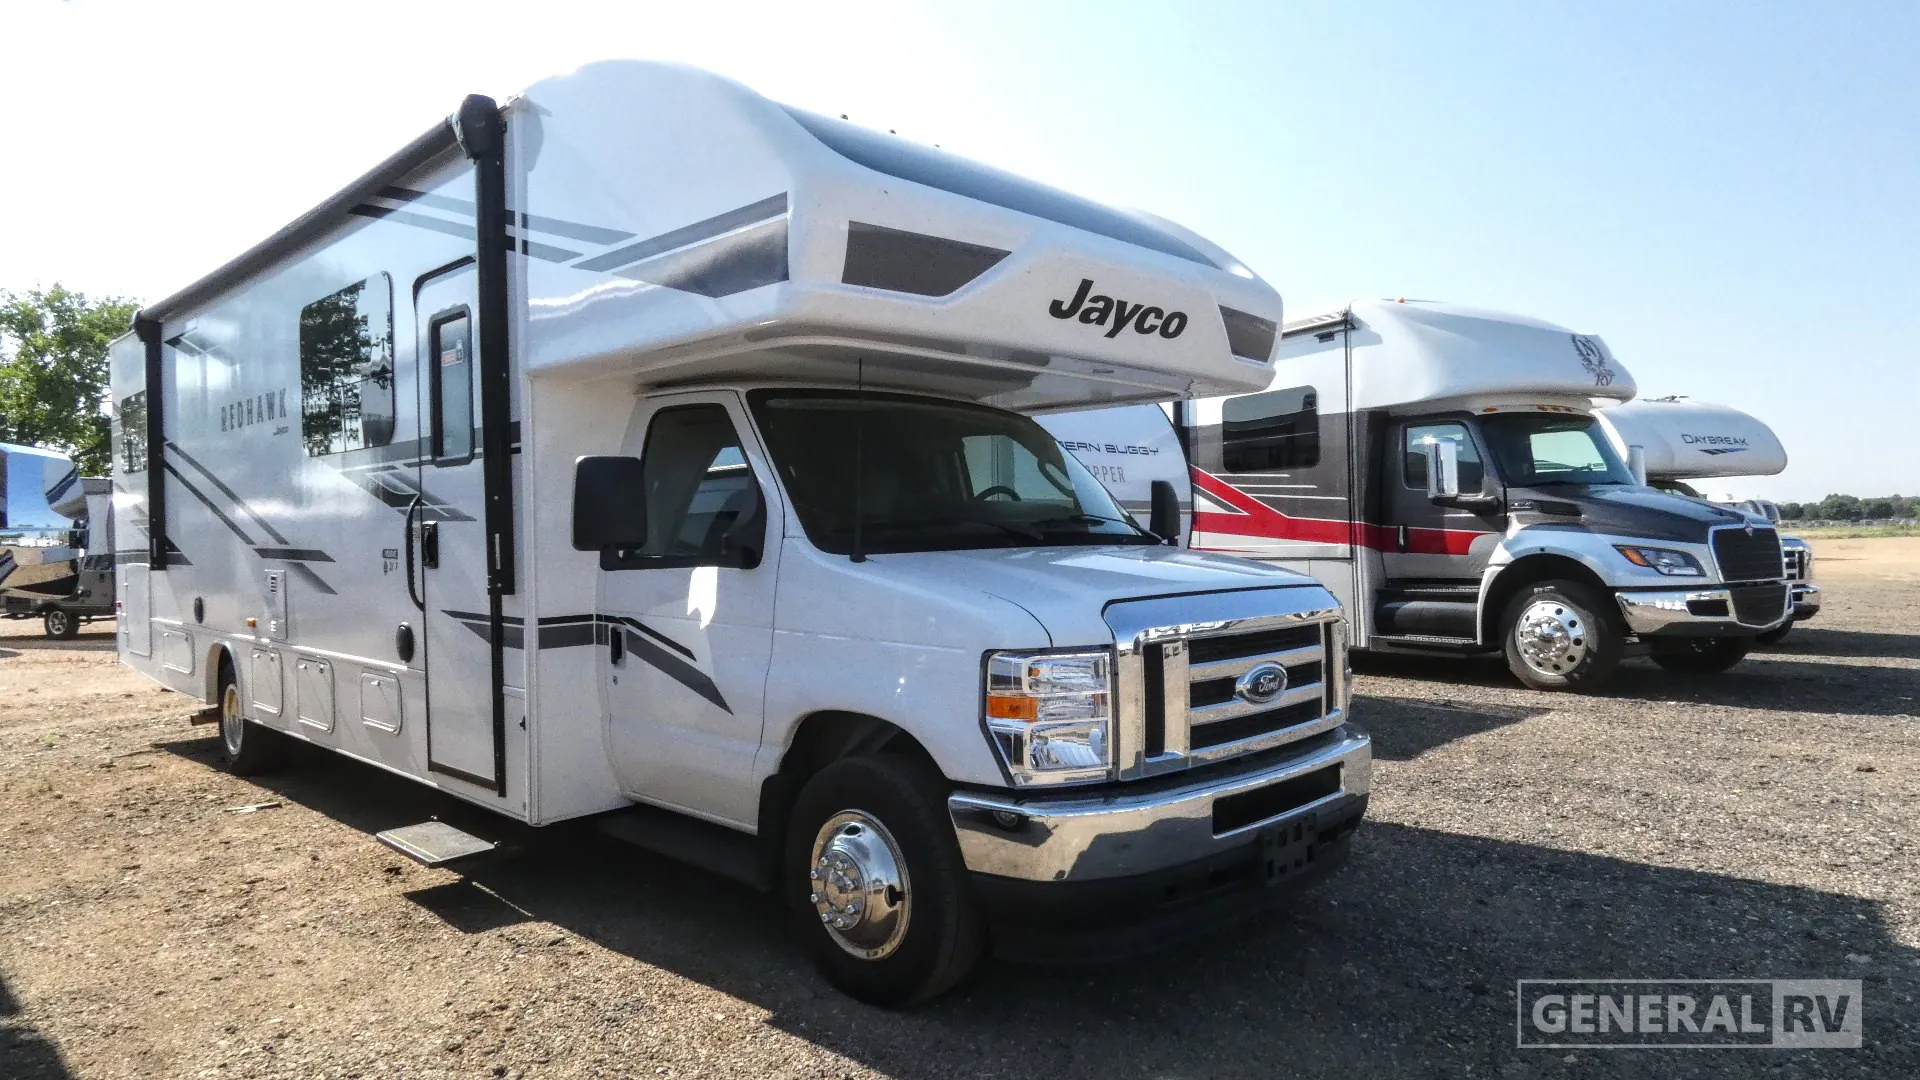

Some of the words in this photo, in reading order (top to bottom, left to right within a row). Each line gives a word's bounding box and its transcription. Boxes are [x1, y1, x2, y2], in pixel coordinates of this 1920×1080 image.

[1048, 278, 1188, 339] Jayco
[221, 388, 287, 432] REDHAWK
[1681, 433, 1749, 446] DAYBREAK
[1105, 444, 1159, 455] BUGGY
[1258, 674, 1280, 693] Ford
